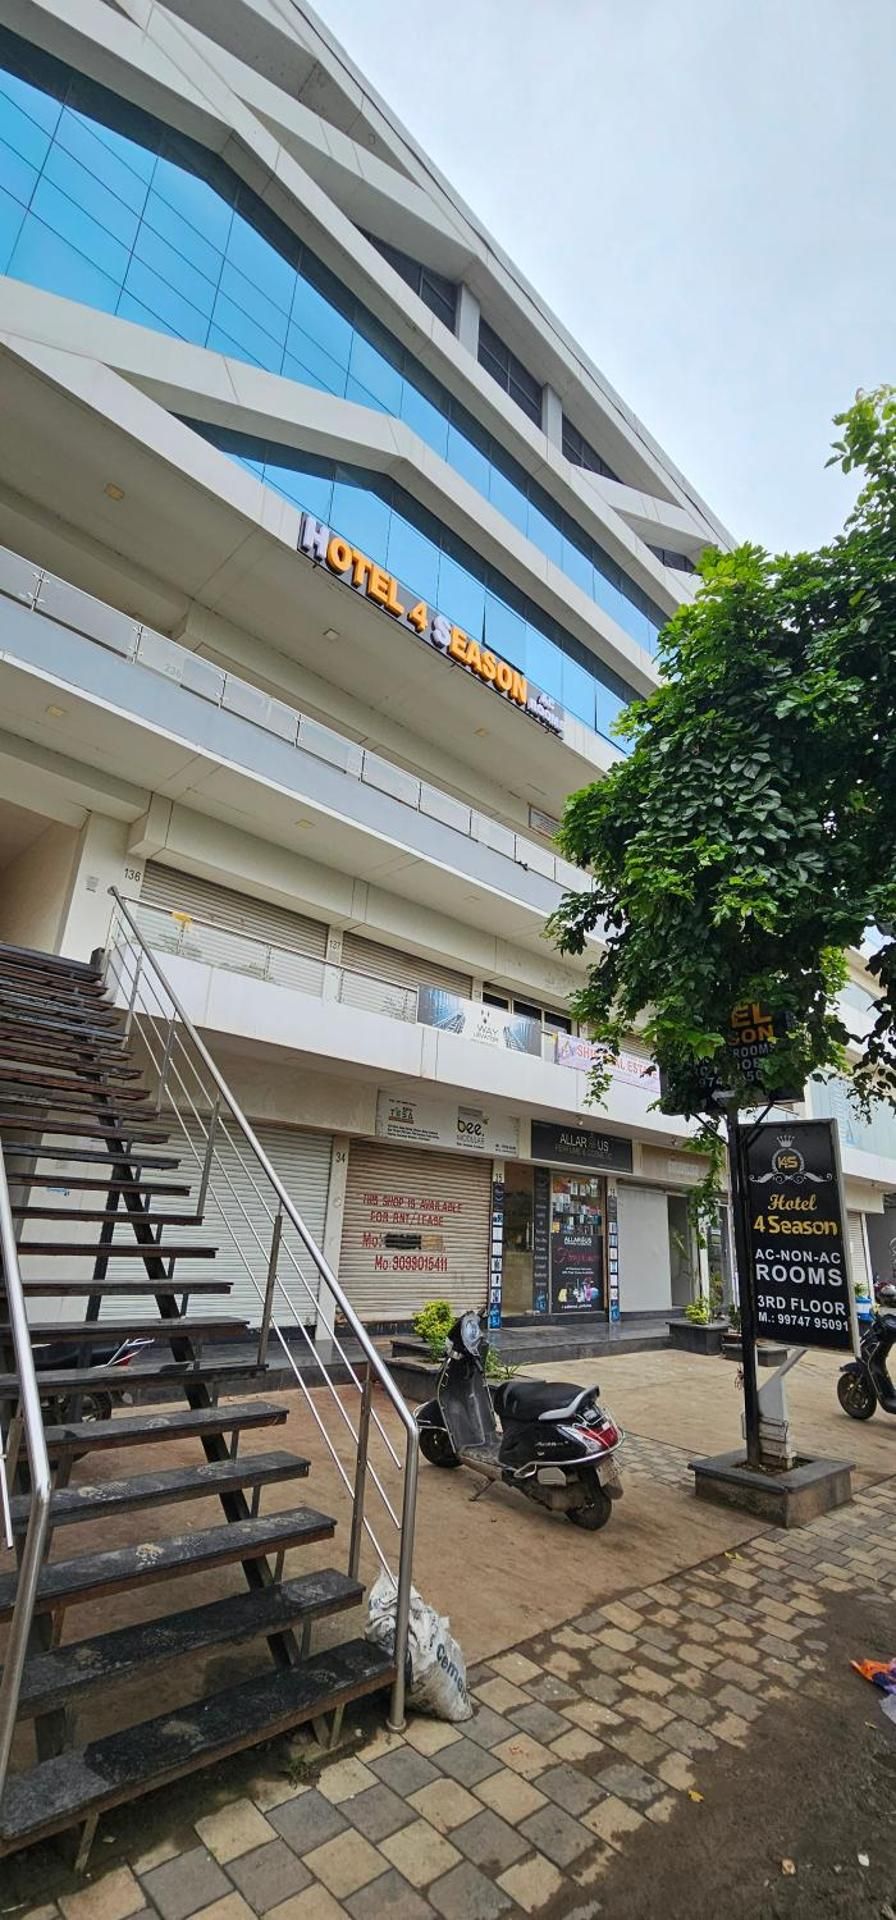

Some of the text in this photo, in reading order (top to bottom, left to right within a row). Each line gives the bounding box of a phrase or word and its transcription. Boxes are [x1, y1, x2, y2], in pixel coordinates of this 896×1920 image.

[301, 516, 527, 705] HOTEL 4 SEASON
[124, 868, 142, 881] 136
[363, 1193, 378, 1206] THIS
[382, 1194, 404, 1207] SHOP
[419, 1199, 464, 1213] AVAILABLE
[768, 1194, 818, 1211] Hotel
[370, 1210, 389, 1223] FOR
[753, 1215, 838, 1236] 4 Season
[755, 1248, 841, 1264] AC-NON-AC
[755, 1263, 843, 1287] ROOMS
[757, 1294, 846, 1316] 3RD FLOOR
[777, 1313, 811, 1328] 99747
[814, 1317, 849, 1332] 95091
